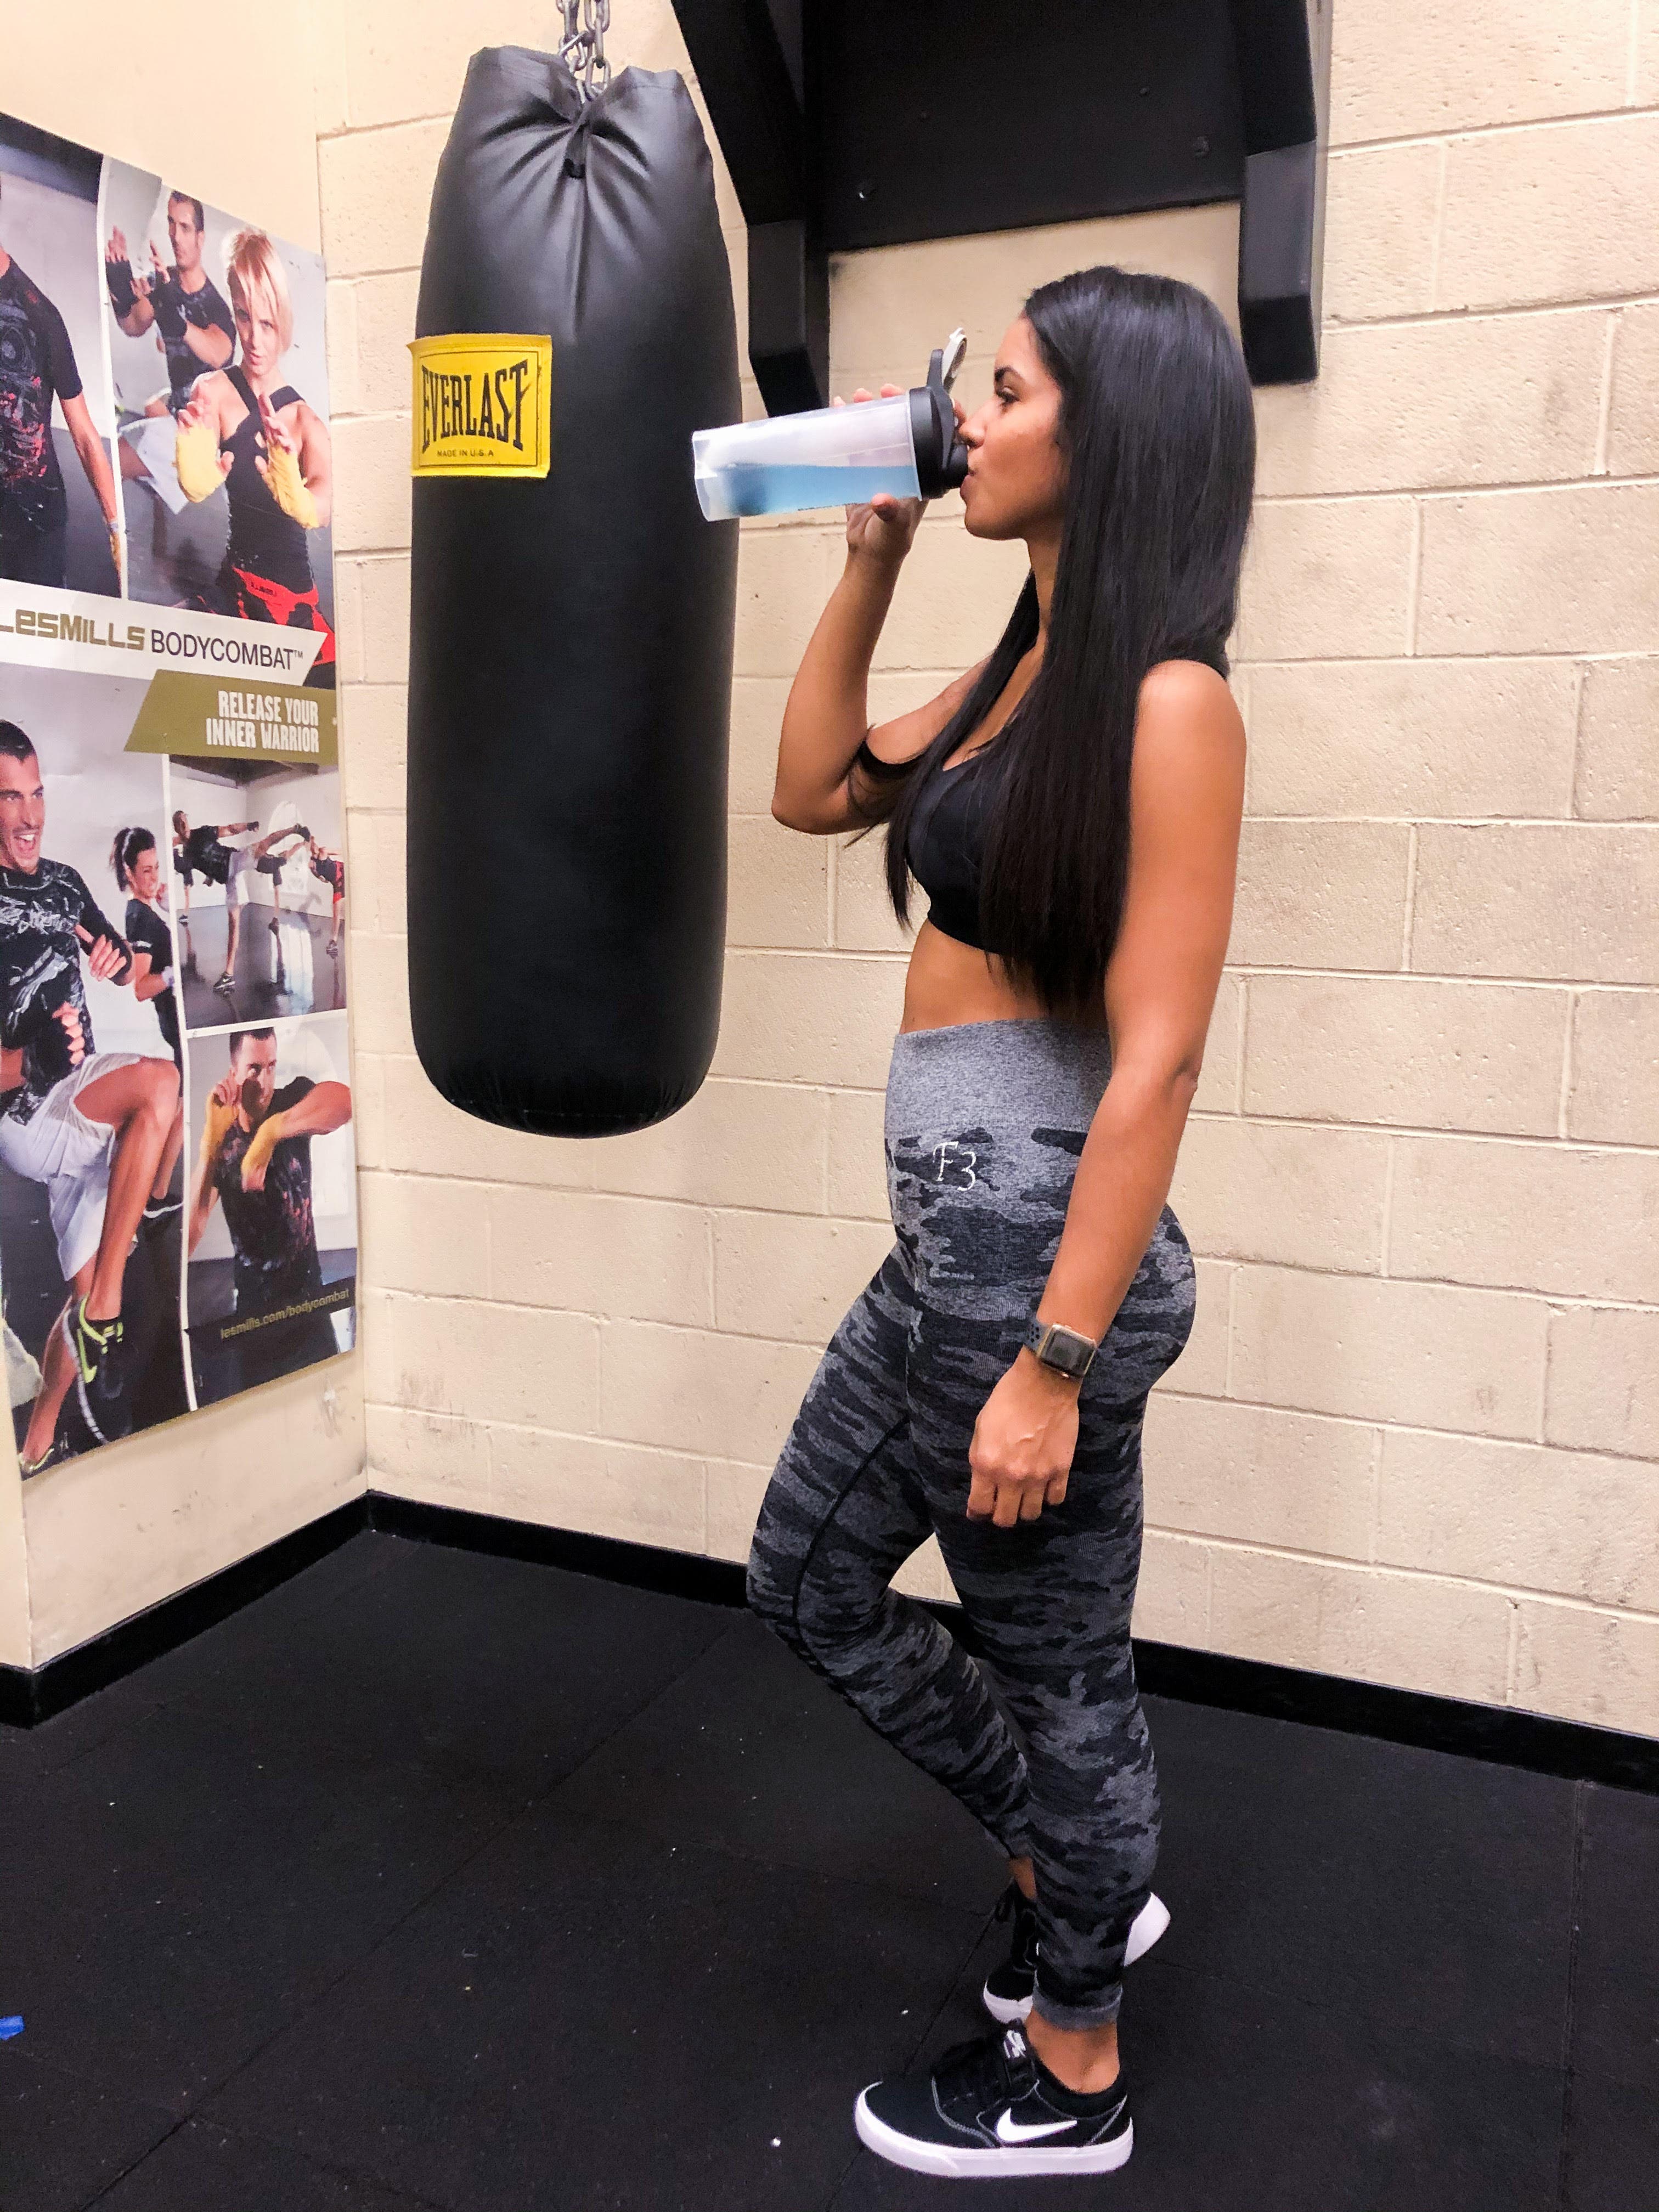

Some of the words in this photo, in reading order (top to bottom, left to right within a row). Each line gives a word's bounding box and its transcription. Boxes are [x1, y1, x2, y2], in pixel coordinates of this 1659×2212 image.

[421, 359, 528, 454] EVERLAST
[218, 690, 282, 723] RELEASE
[284, 697, 319, 726] YOUR
[206, 717, 257, 748] INNER
[260, 722, 319, 753] WARRIOR
[221, 1288, 350, 1340] lesmills.com/bodycombat
